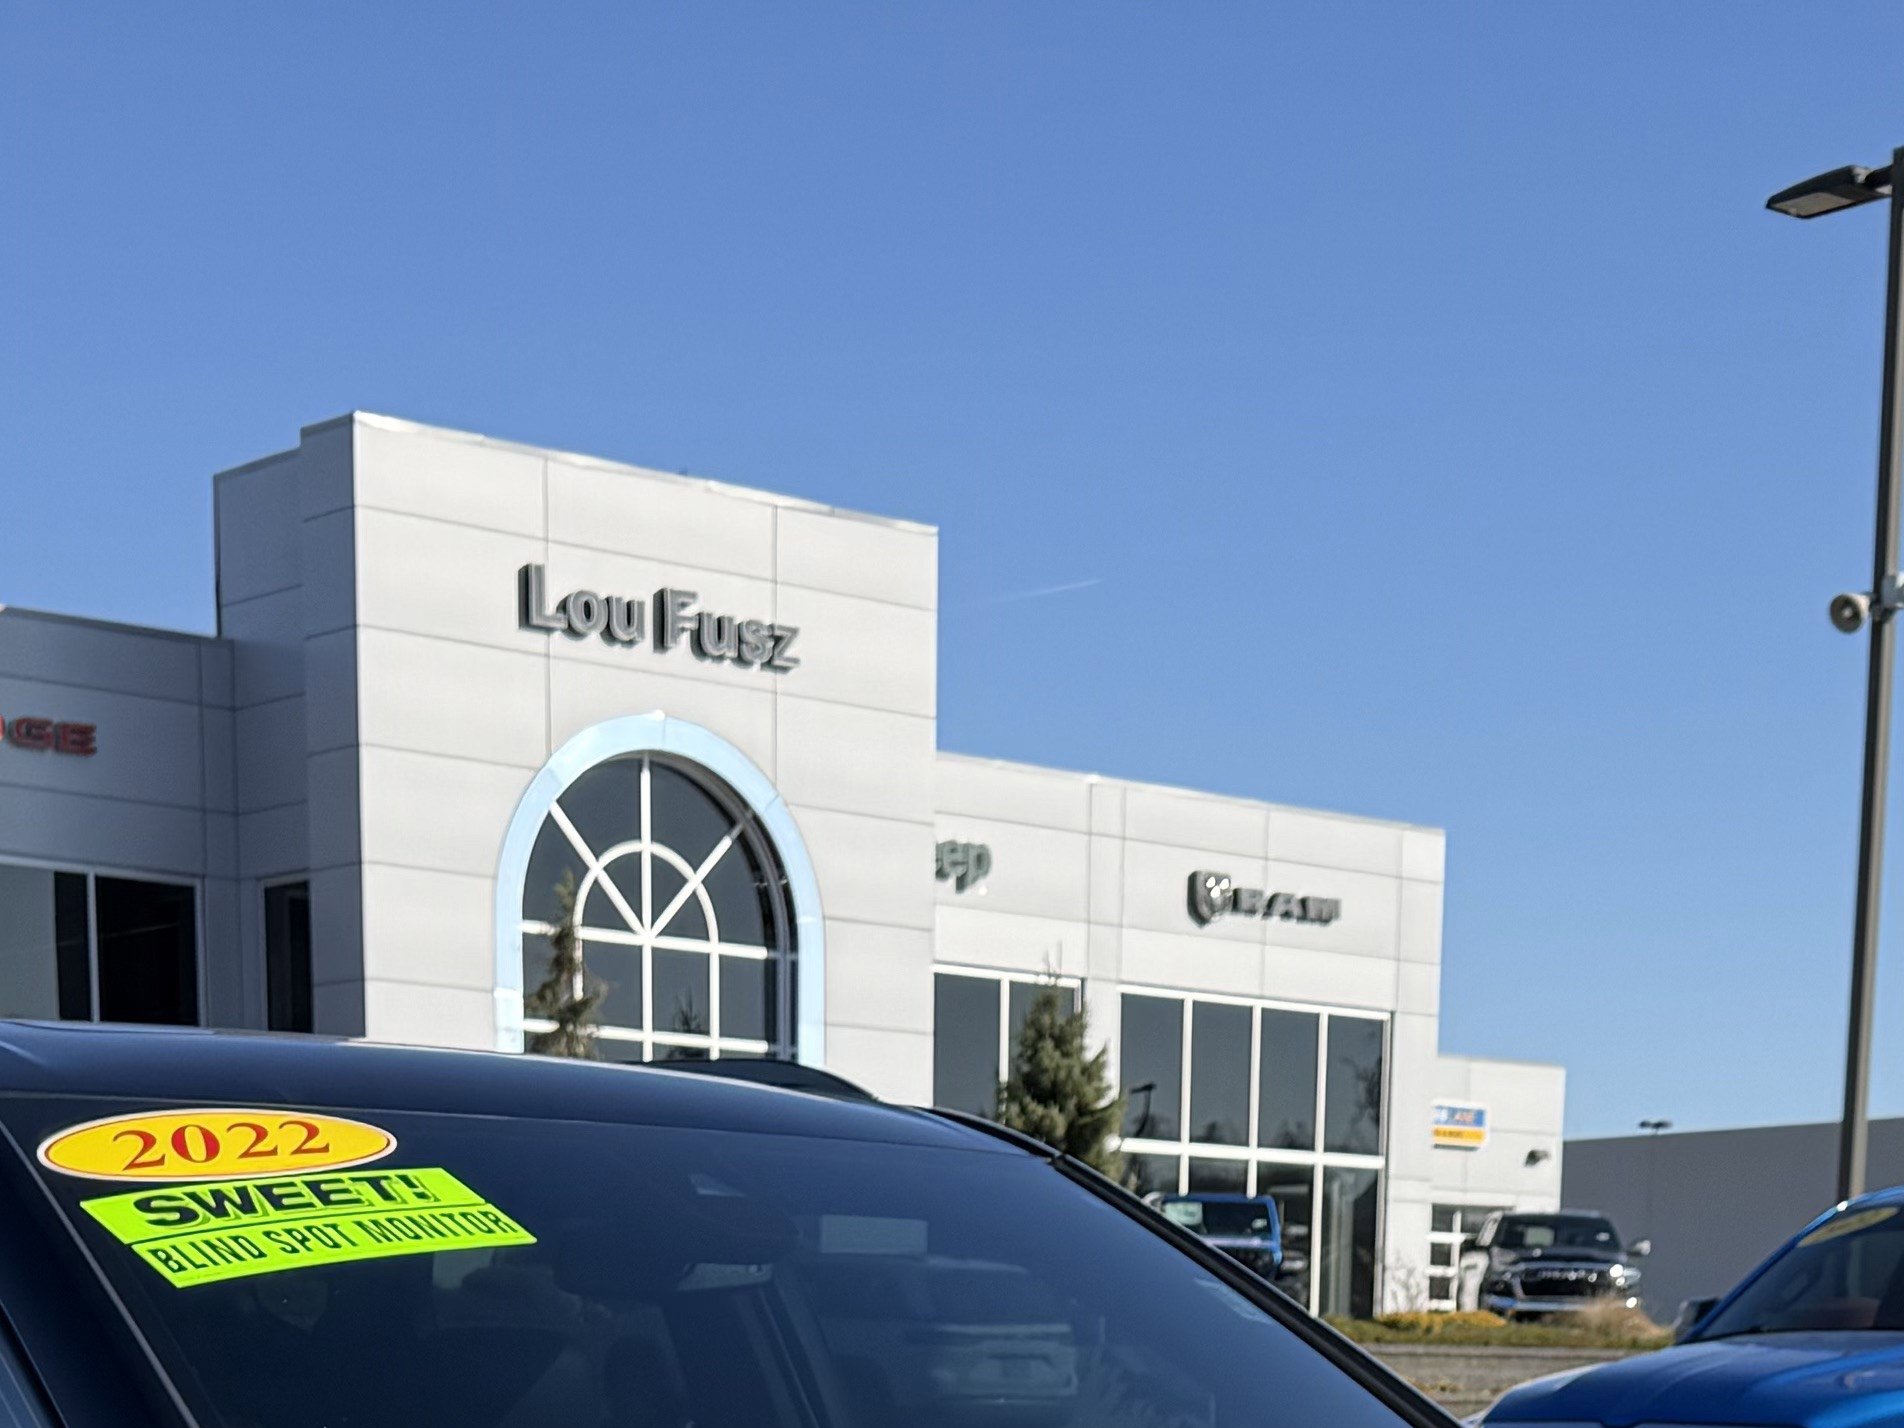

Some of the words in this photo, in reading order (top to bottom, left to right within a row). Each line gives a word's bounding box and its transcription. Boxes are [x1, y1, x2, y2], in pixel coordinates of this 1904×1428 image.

[518, 563, 645, 647] Lou
[653, 587, 801, 673] Fusz
[112, 1120, 330, 1171] 2022
[133, 1174, 438, 1228] SWEET!
[147, 1234, 267, 1273] BLIND
[263, 1223, 359, 1254] SPOT
[356, 1209, 518, 1243] MONITOR
